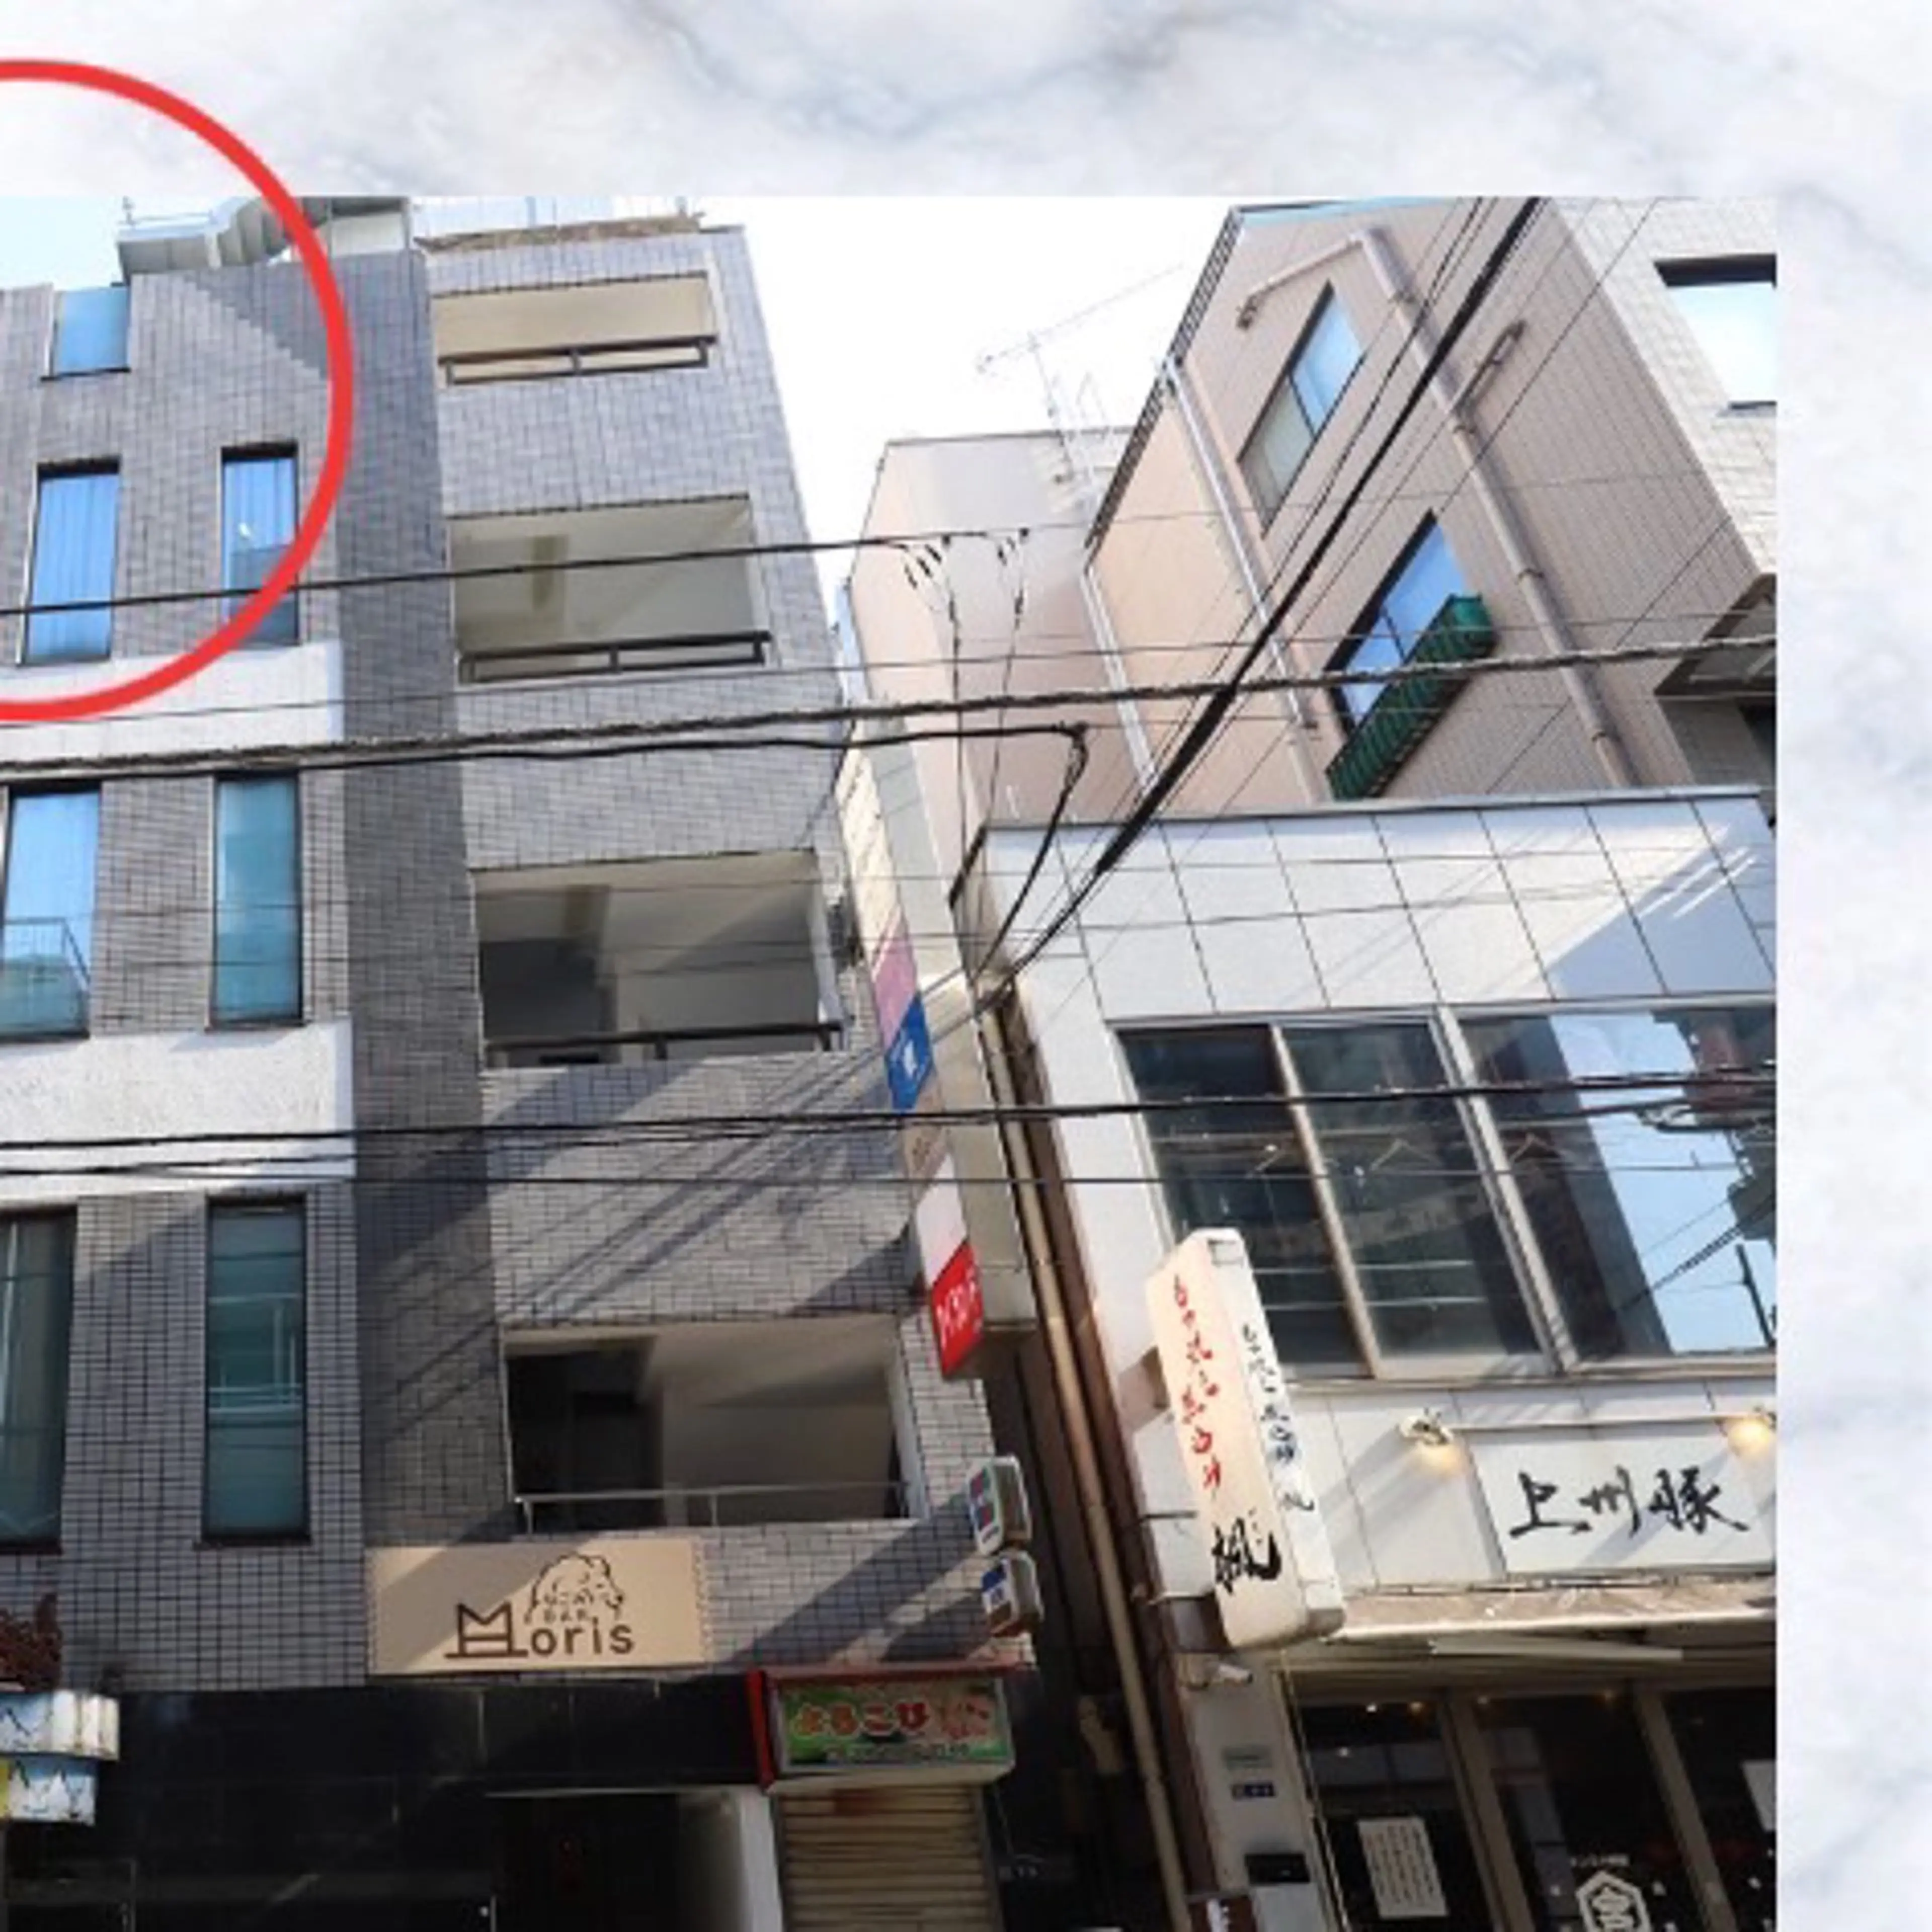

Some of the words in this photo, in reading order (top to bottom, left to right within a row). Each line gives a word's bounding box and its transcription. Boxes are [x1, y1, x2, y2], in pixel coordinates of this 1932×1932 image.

[1508, 1464, 1750, 1539] 上州豚
[444, 1602, 635, 1658] Moris
